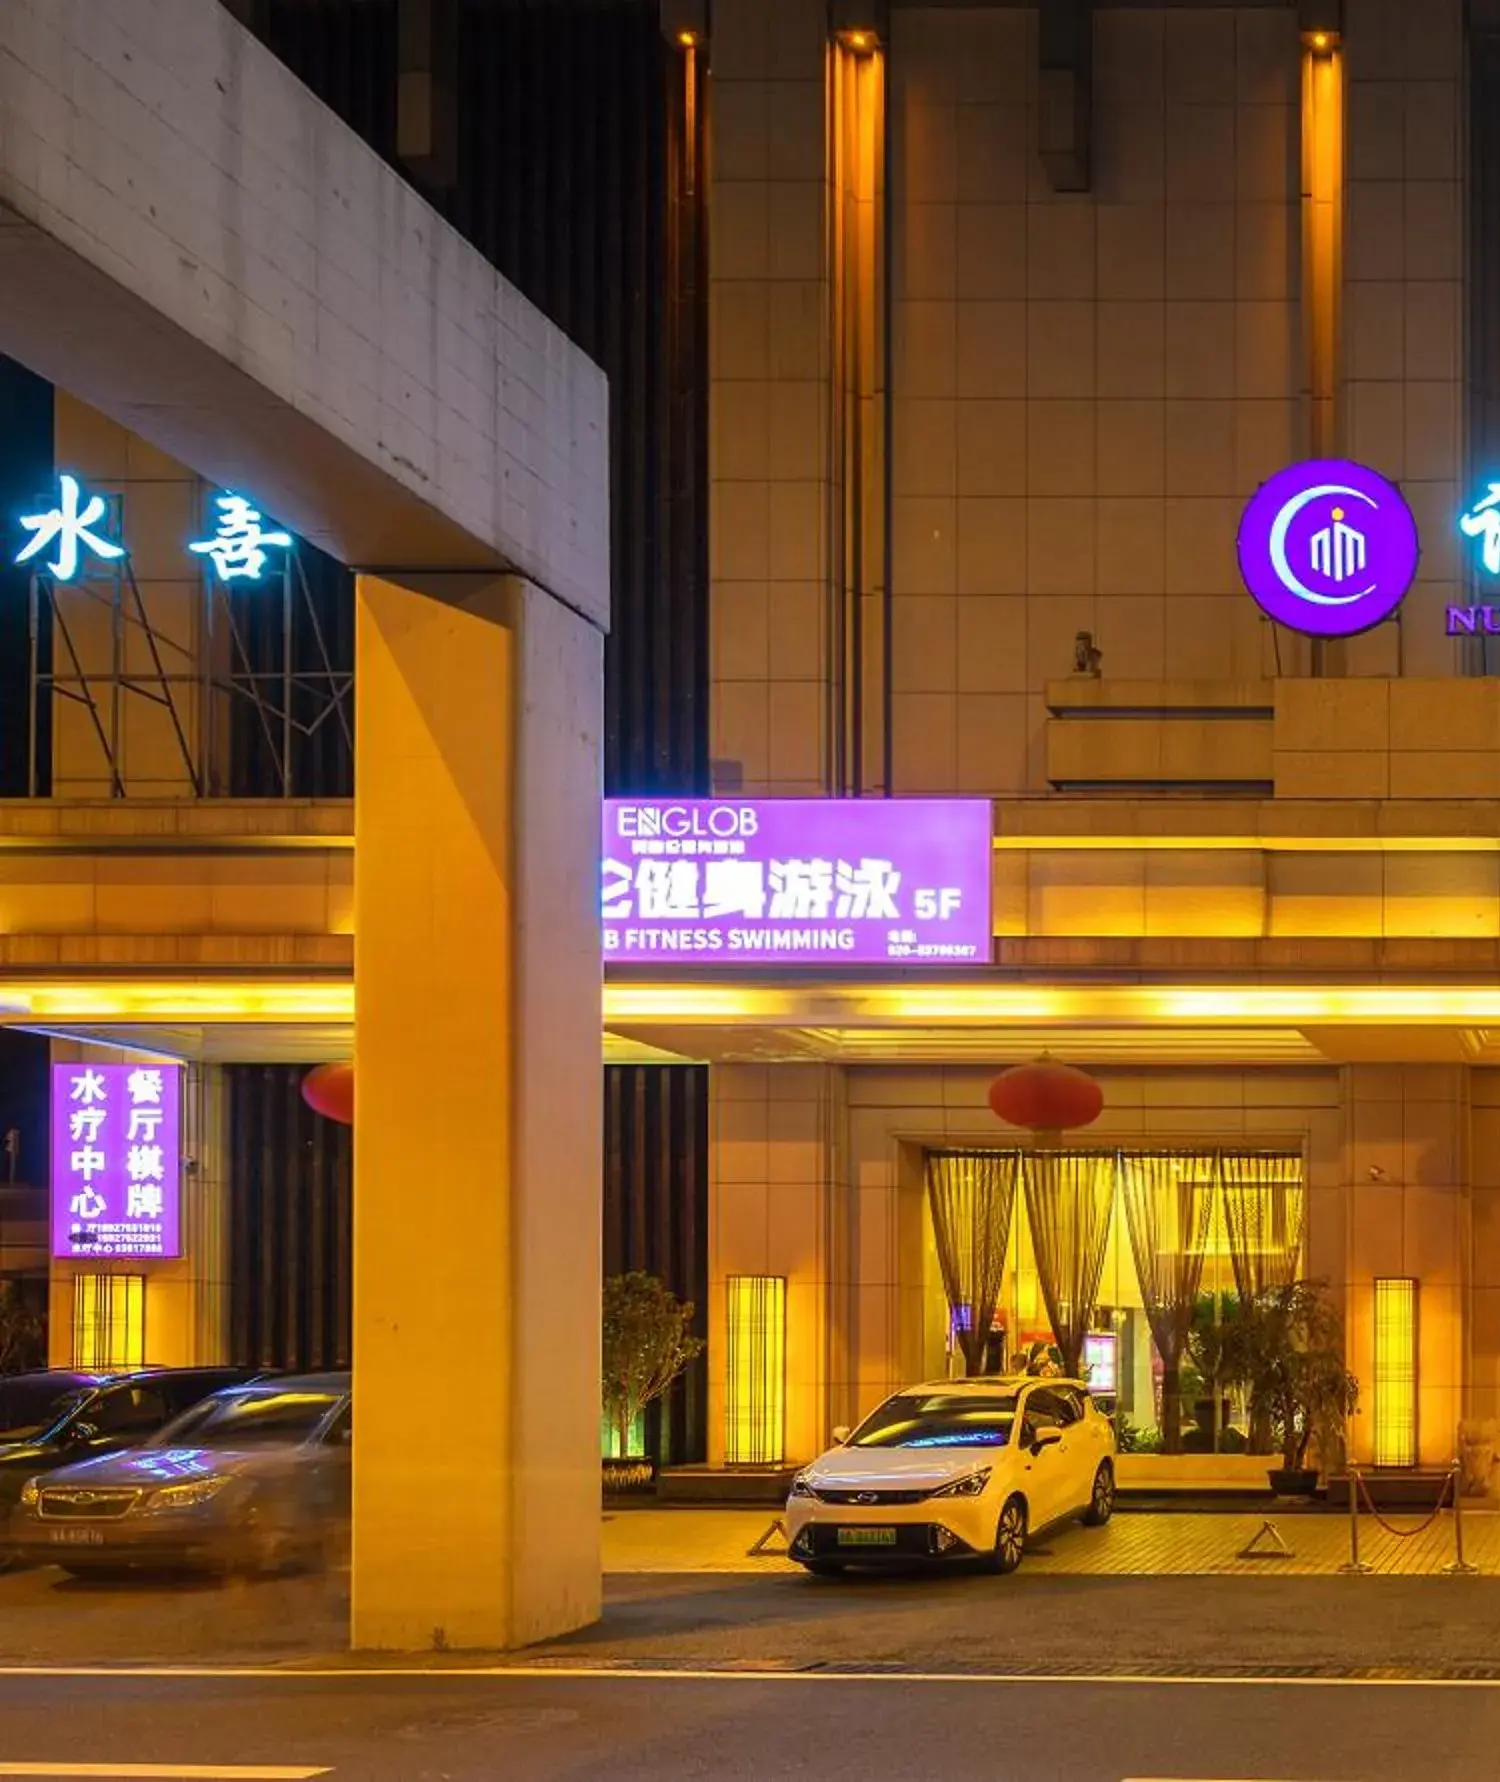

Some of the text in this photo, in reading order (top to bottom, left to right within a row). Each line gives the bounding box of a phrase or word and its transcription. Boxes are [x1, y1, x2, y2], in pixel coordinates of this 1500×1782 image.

[617, 807, 758, 837] ENGLOB
[915, 888, 961, 919] 5F
[625, 928, 723, 950] FITNESS
[727, 928, 855, 950] SWIMMING
[70, 1068, 107, 1218] 水疗中心
[127, 1069, 164, 1218] 餐厅棋牌
